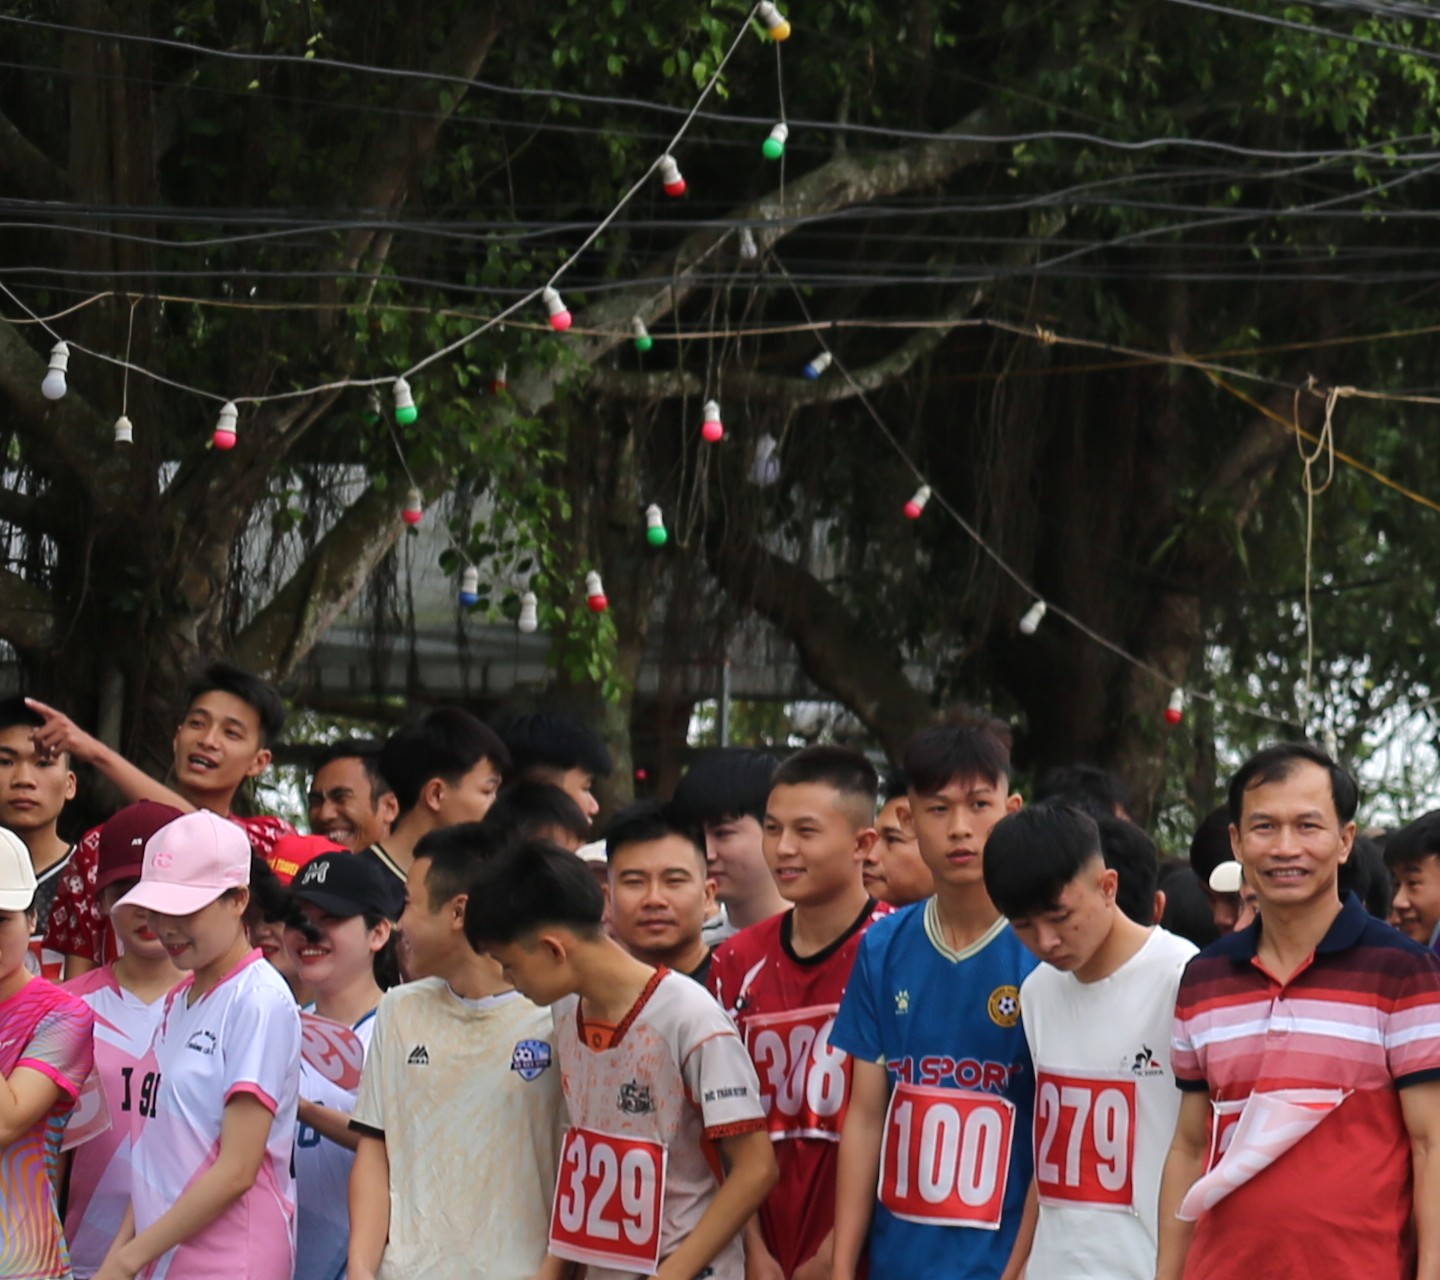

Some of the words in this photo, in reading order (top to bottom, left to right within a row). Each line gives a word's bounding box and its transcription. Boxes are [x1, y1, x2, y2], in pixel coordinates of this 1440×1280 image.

[754, 1019, 845, 1116] 308
[894, 1102, 1002, 1206] 100
[1039, 1089, 1132, 1191] 279
[558, 1142, 654, 1245] 329
